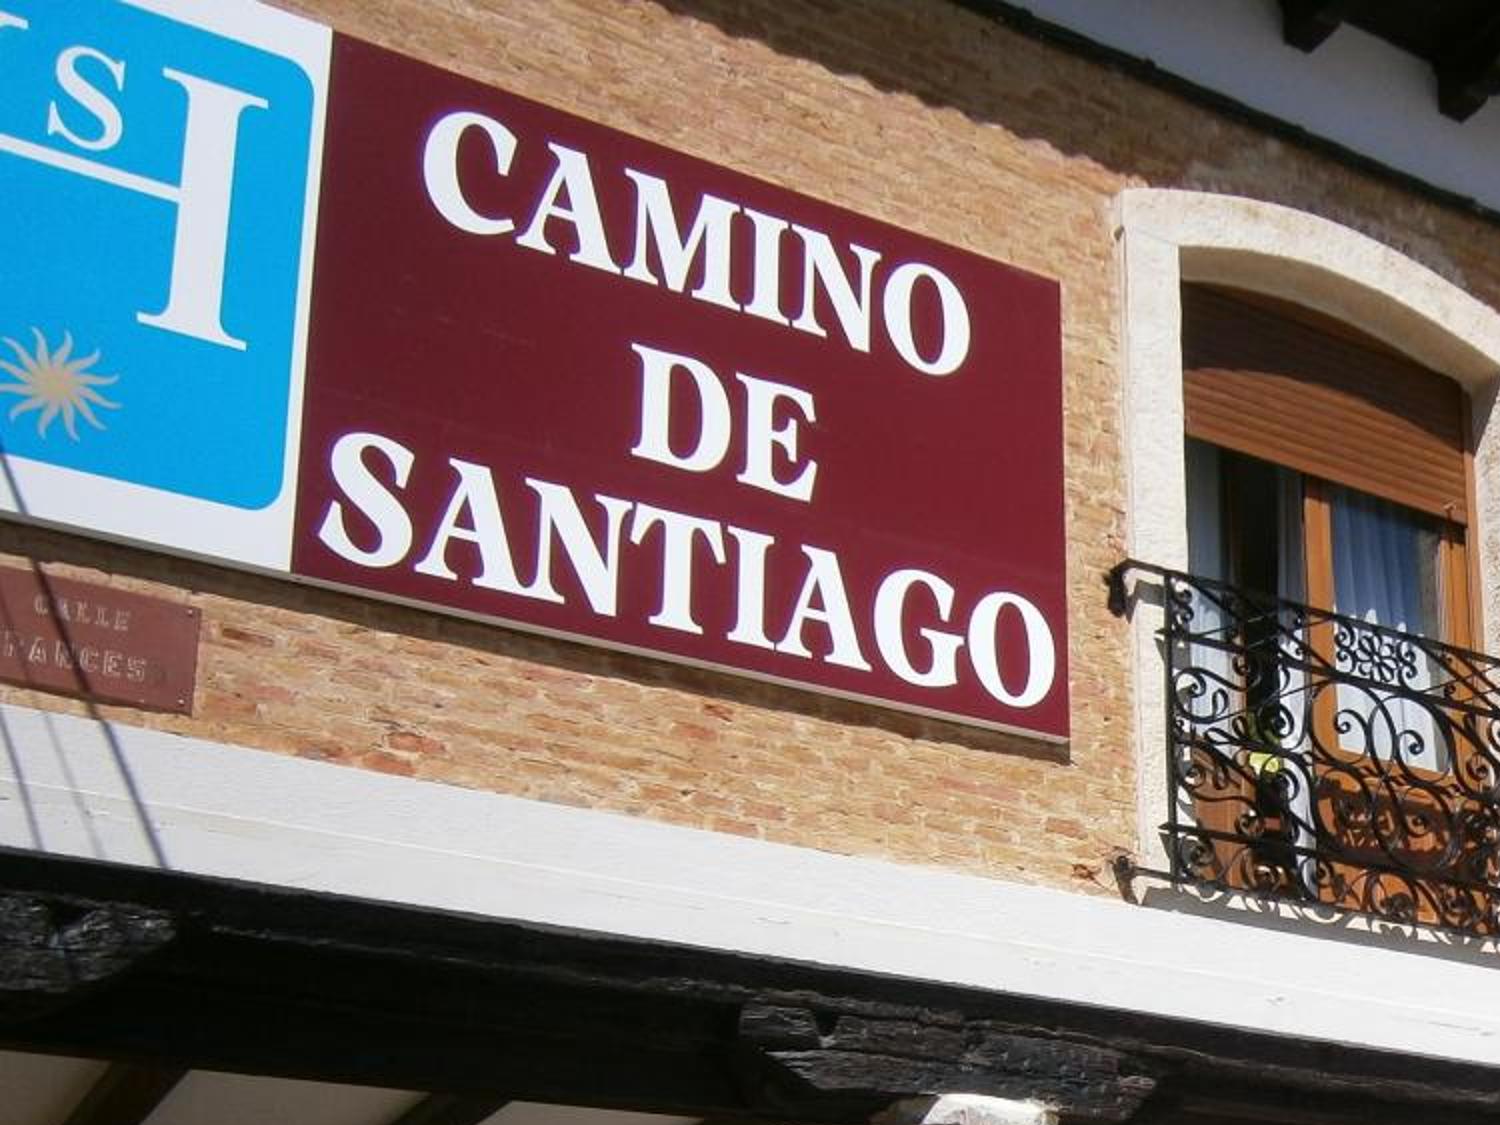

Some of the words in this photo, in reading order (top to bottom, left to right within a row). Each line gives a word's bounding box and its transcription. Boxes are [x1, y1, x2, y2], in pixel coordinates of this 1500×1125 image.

[423, 111, 971, 376] CAMINO
[631, 343, 818, 502] DE
[35, 595, 130, 631] CALLE
[318, 432, 1056, 708] SANTIAGO
